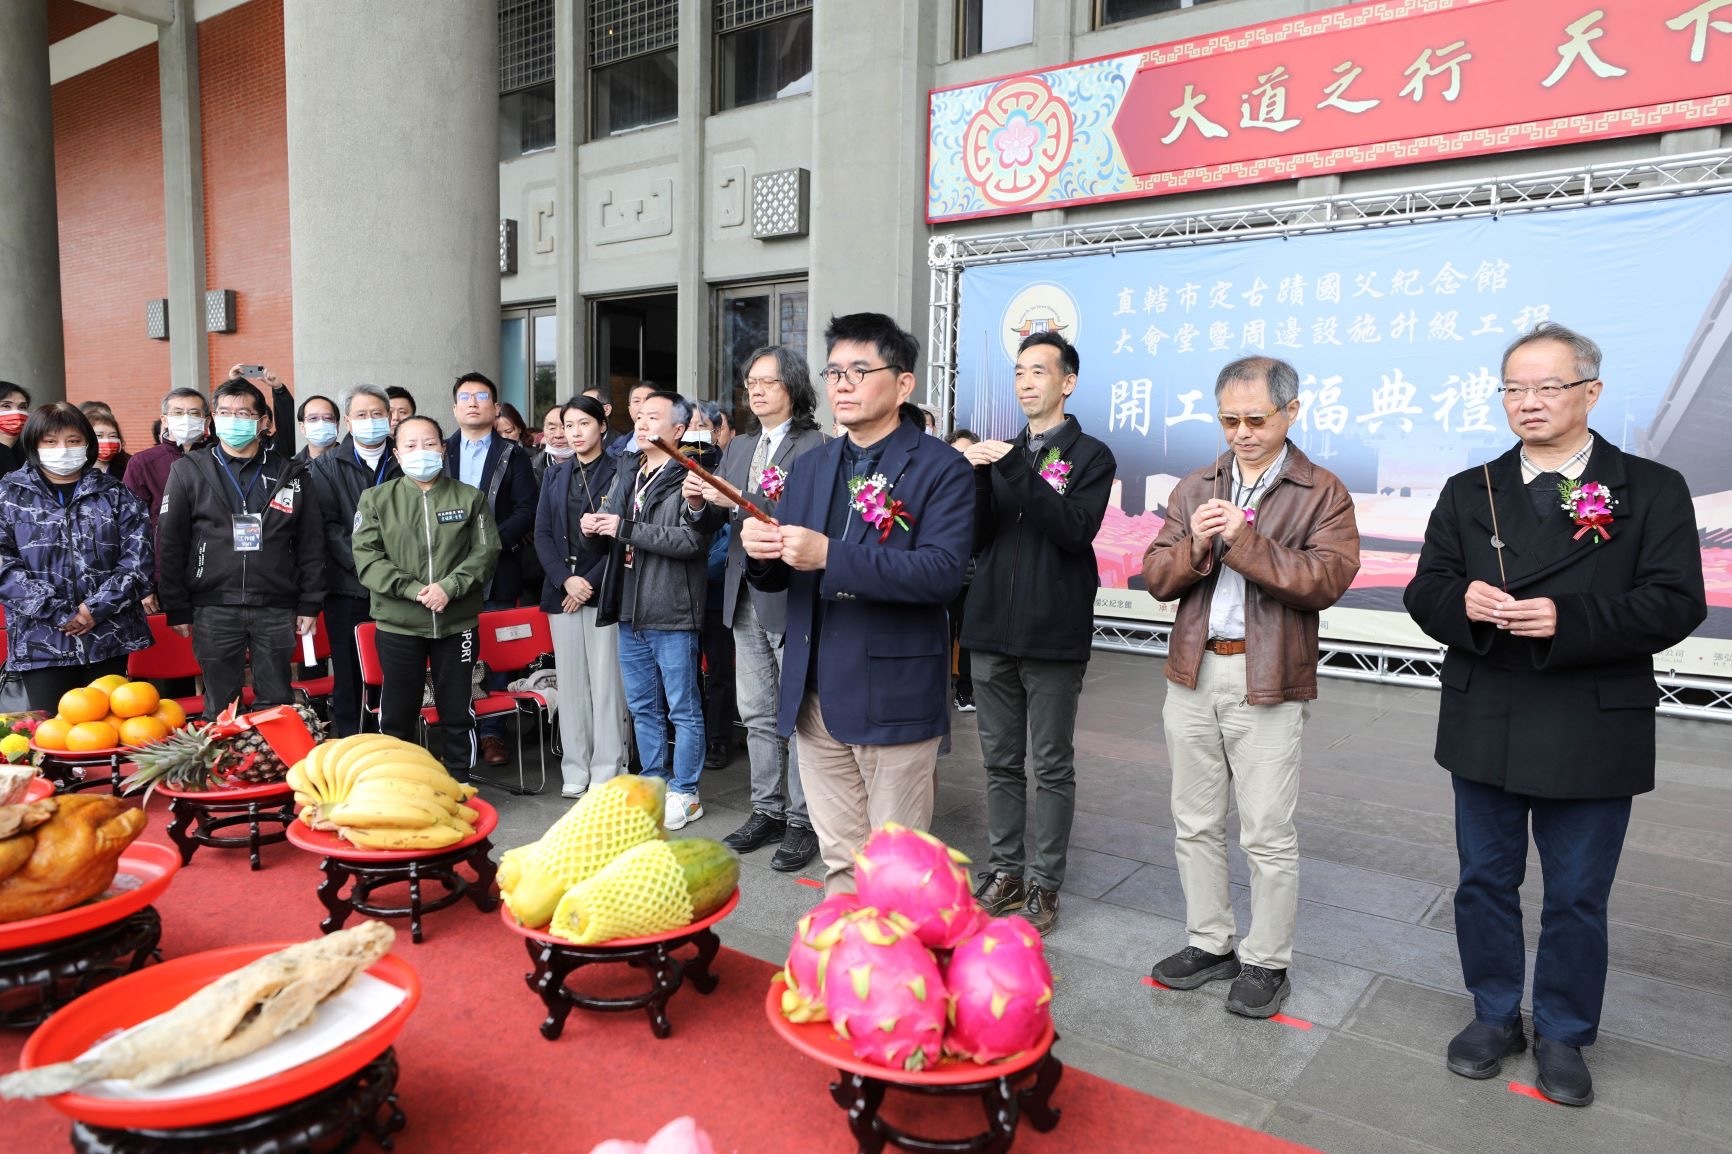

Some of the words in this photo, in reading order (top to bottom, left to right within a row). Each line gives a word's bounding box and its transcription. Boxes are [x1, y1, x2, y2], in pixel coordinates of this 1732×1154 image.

[1160, 40, 1473, 144] 大道之行
[1112, 259, 1512, 316] 直轄市定古蹟國父紀念館
[1109, 366, 1500, 436] 開工福典禮
